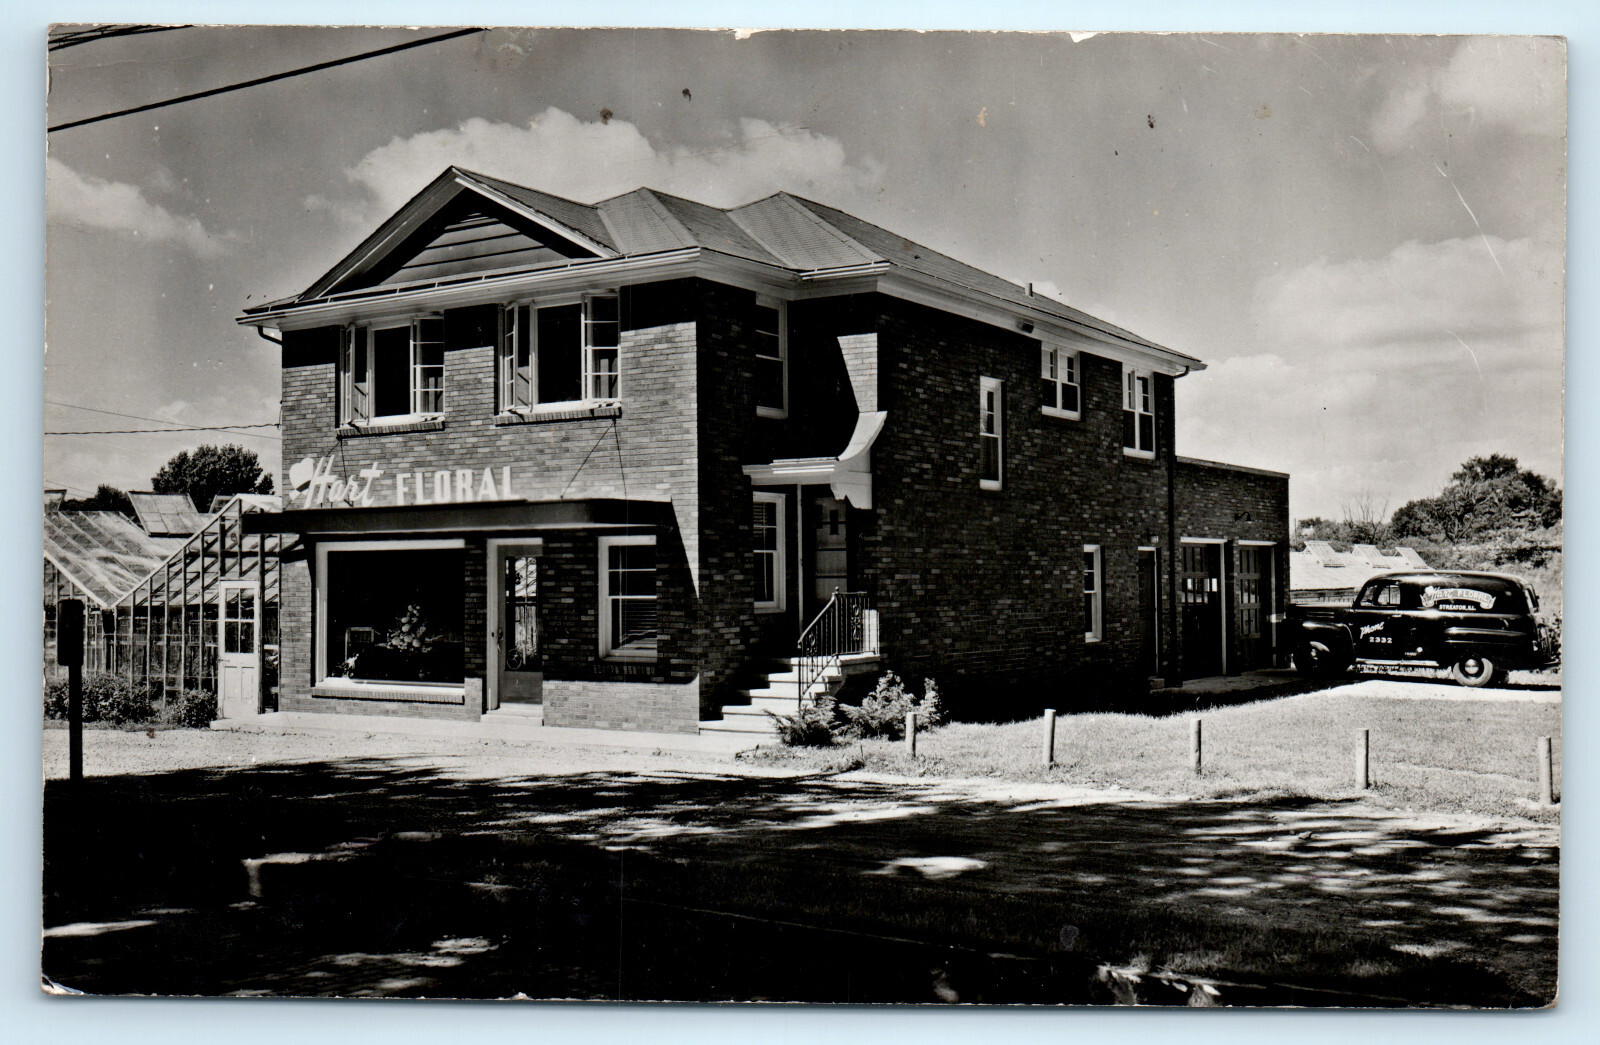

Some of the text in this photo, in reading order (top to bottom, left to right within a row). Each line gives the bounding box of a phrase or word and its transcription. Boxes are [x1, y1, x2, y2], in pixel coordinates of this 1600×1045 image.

[303, 455, 520, 509] Hart FLORAL
[1457, 590, 1489, 603] FLORAL
[1369, 636, 1393, 644] 2332
